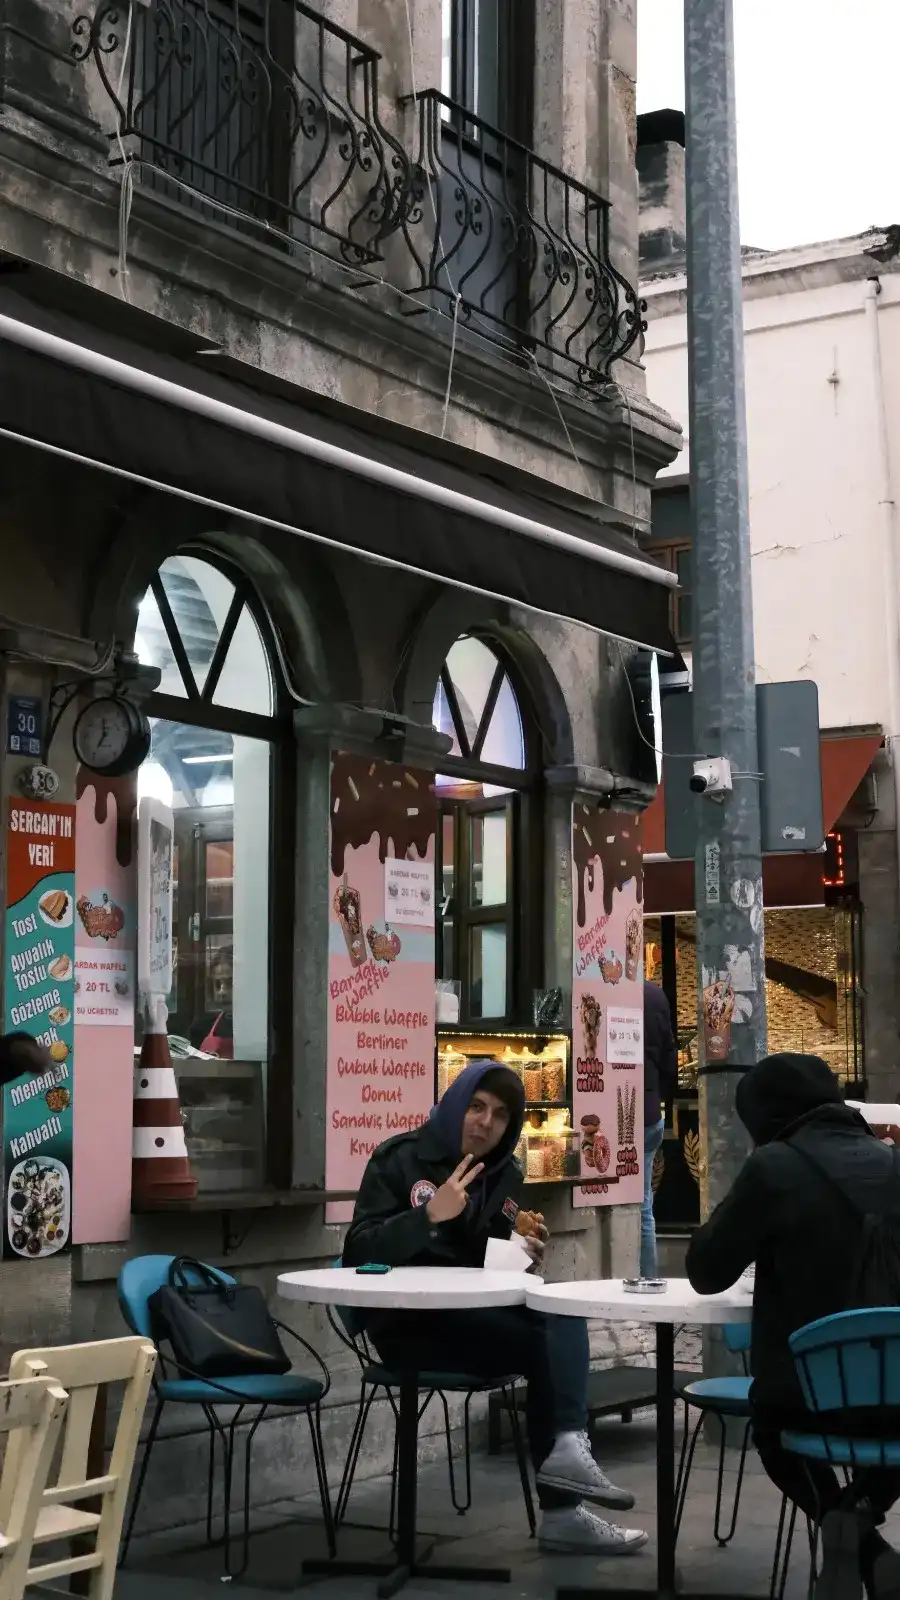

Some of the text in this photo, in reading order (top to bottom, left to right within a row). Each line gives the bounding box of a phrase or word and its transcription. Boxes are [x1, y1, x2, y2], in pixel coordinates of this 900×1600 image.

[18, 713, 35, 734] 30
[10, 809, 72, 838] SERCAN'IN
[28, 841, 54, 867] YERİ
[12, 913, 37, 938] Tost
[11, 939, 55, 972] Ayvalık
[74, 961, 98, 969] ARDAK
[14, 965, 47, 991] Tostu
[86, 982, 111, 993] 20 TL
[330, 959, 376, 1000] Bardak
[346, 966, 389, 1011] Waffle
[11, 989, 60, 1025] Gözleme
[335, 1004, 428, 1028] Bubble Waffle
[357, 1032, 408, 1049] Berliner
[337, 1057, 426, 1079] Çubuk Waffle
[10, 1063, 69, 1106] Menemen
[361, 1085, 403, 1103] Donut
[332, 1110, 382, 1130] Sandviç
[10, 1116, 62, 1158] Kahvaltı
